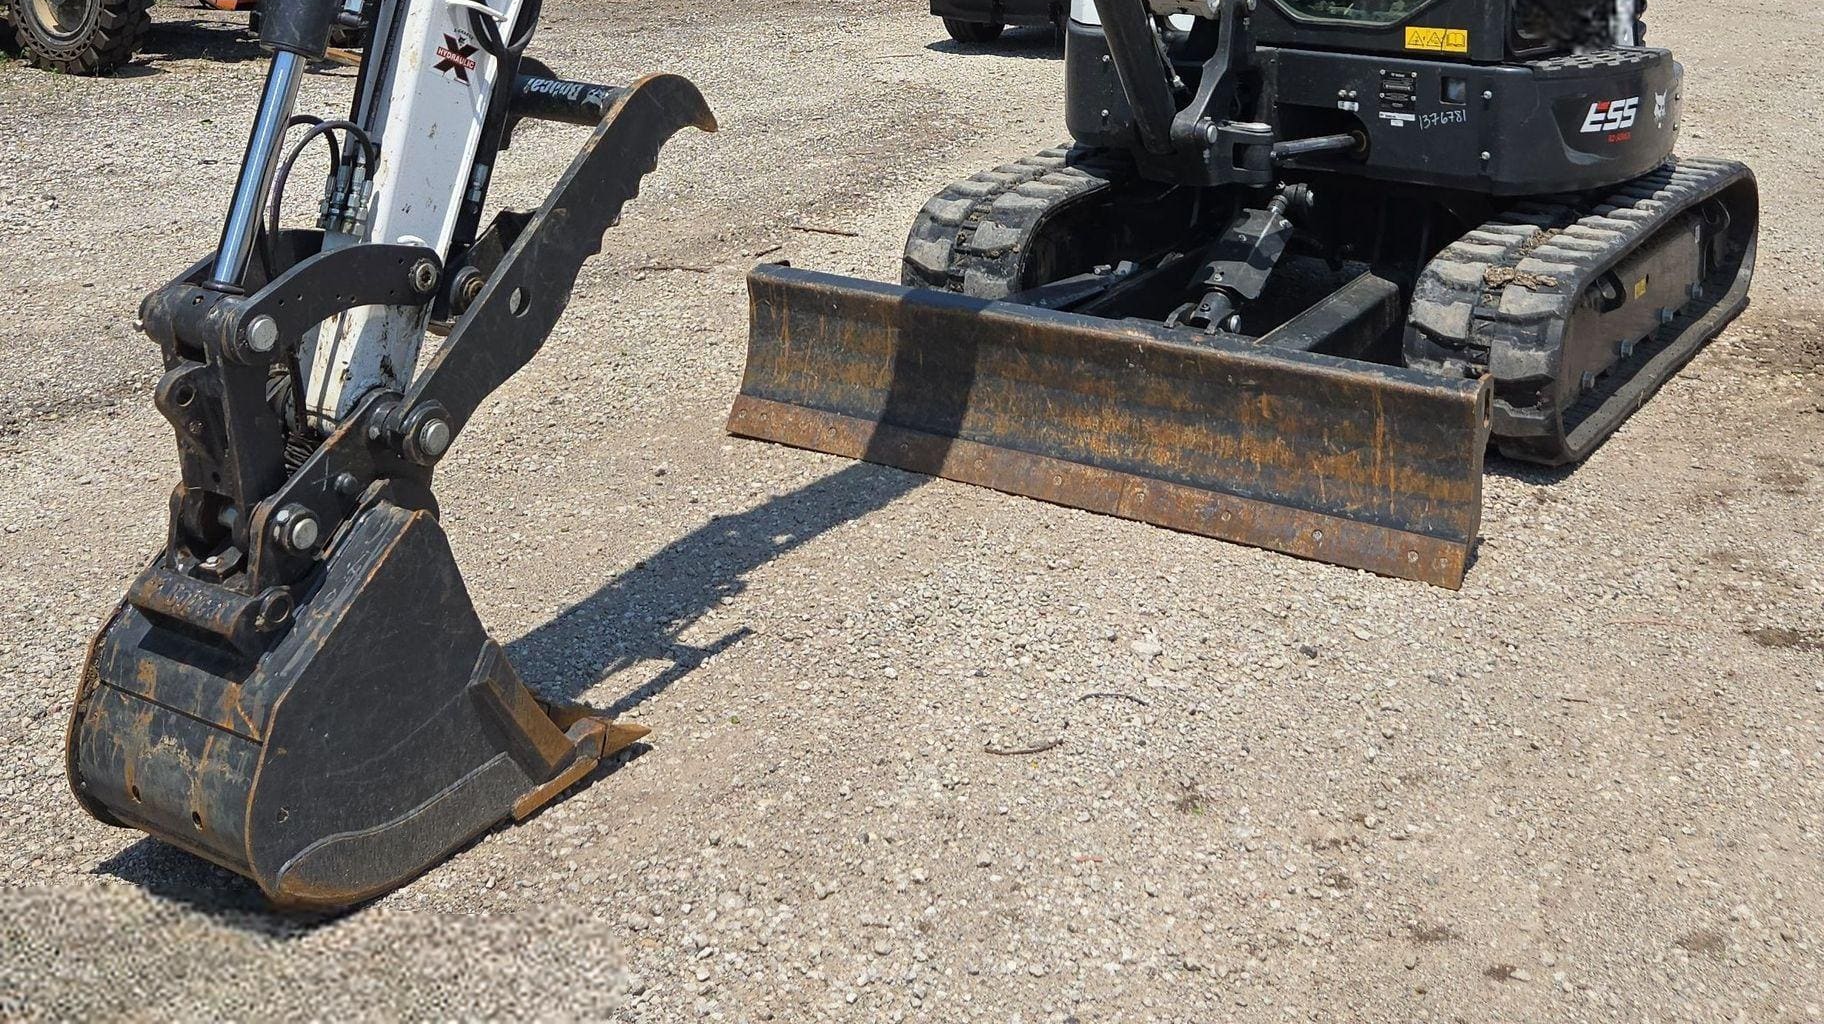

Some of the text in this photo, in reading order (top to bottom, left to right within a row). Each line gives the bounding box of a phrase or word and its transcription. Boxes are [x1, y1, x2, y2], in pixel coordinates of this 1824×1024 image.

[437, 48, 475, 69] HYDRAULIC
[524, 78, 584, 101] Bobcat
[1418, 109, 1467, 131] 1376781
